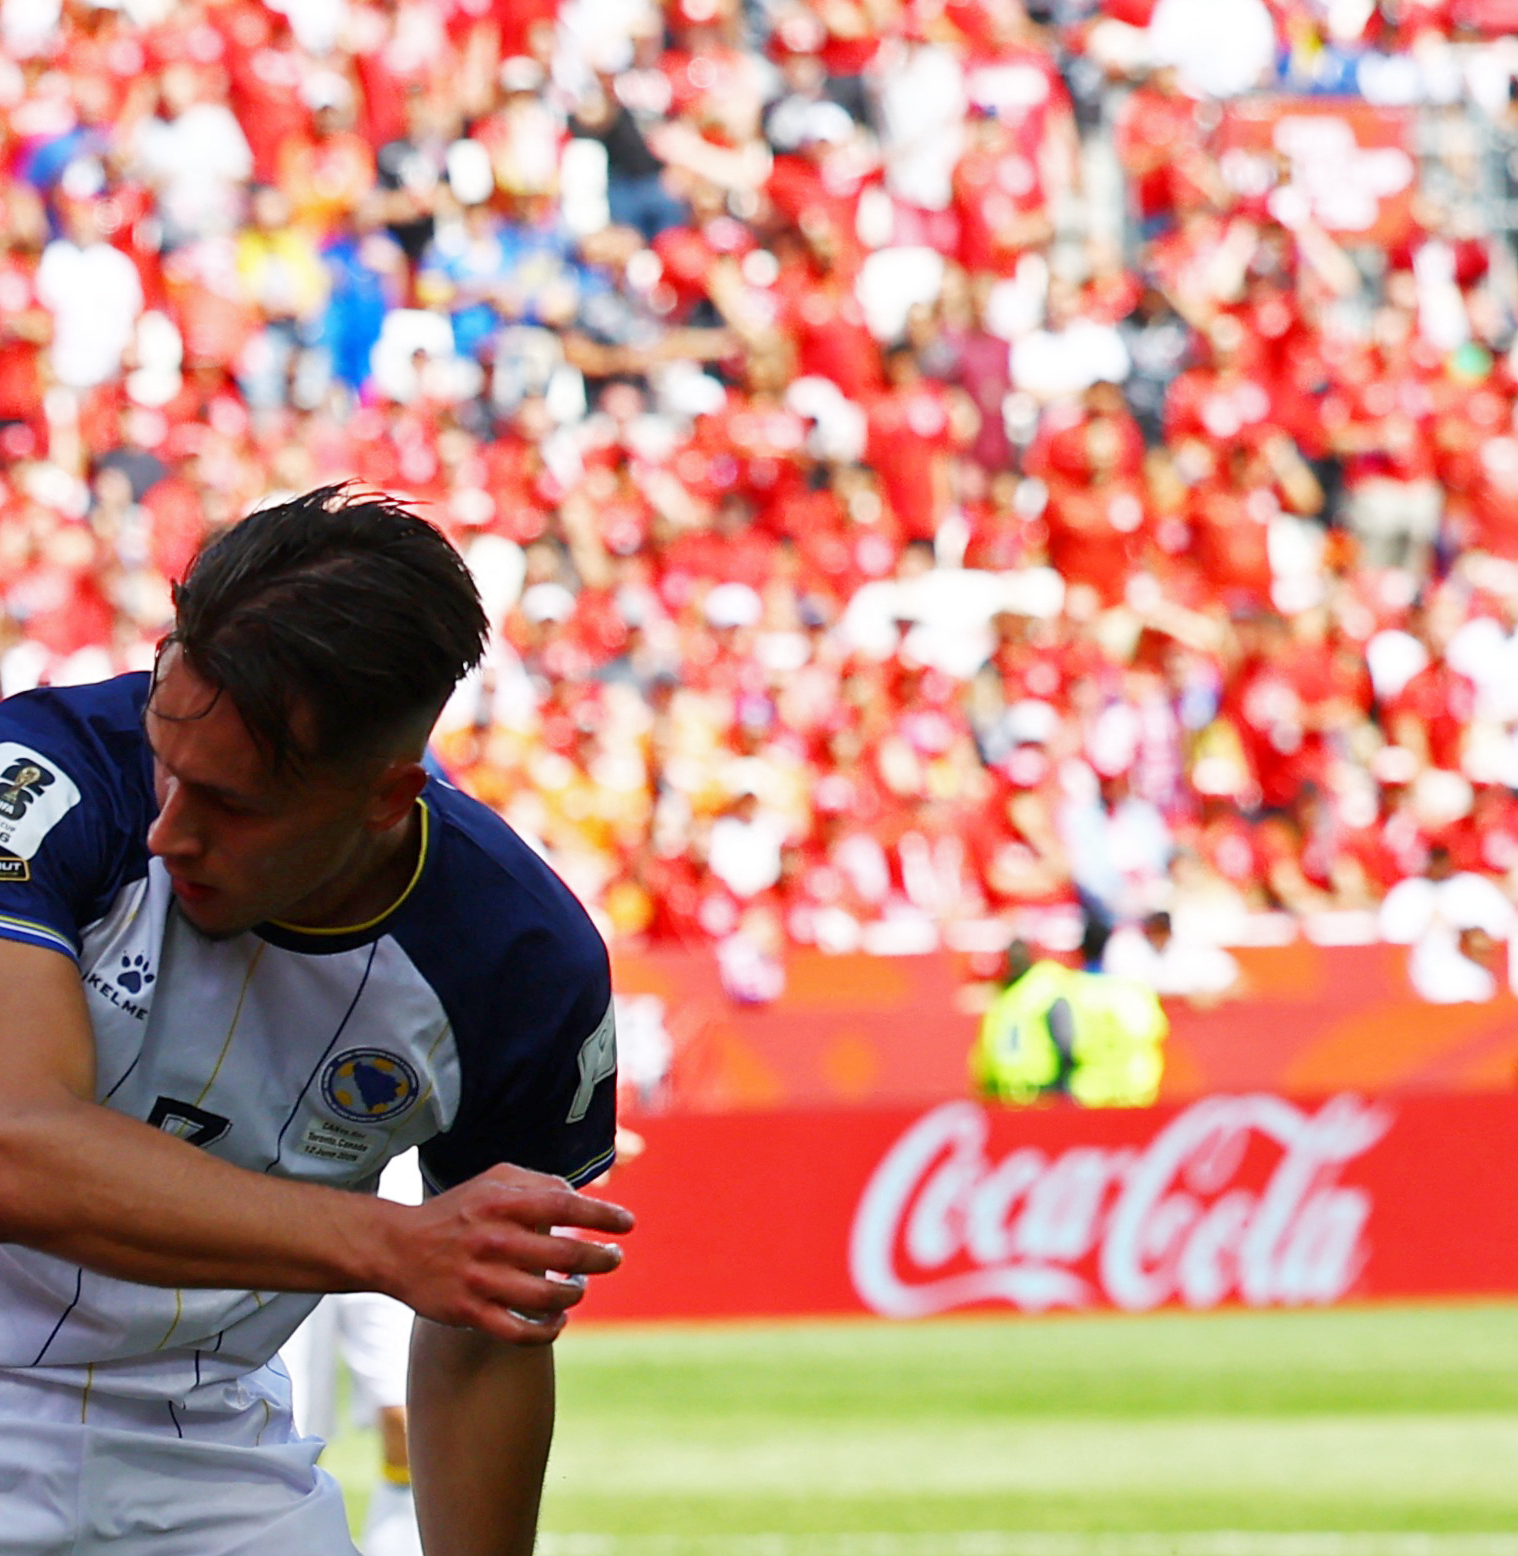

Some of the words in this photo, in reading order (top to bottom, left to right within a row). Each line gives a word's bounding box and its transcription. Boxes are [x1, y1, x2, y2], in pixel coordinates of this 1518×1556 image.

[0, 821, 16, 832] CUP
[87, 972, 149, 1021] KELME
[850, 1092, 1401, 1318] Coca-Cola
